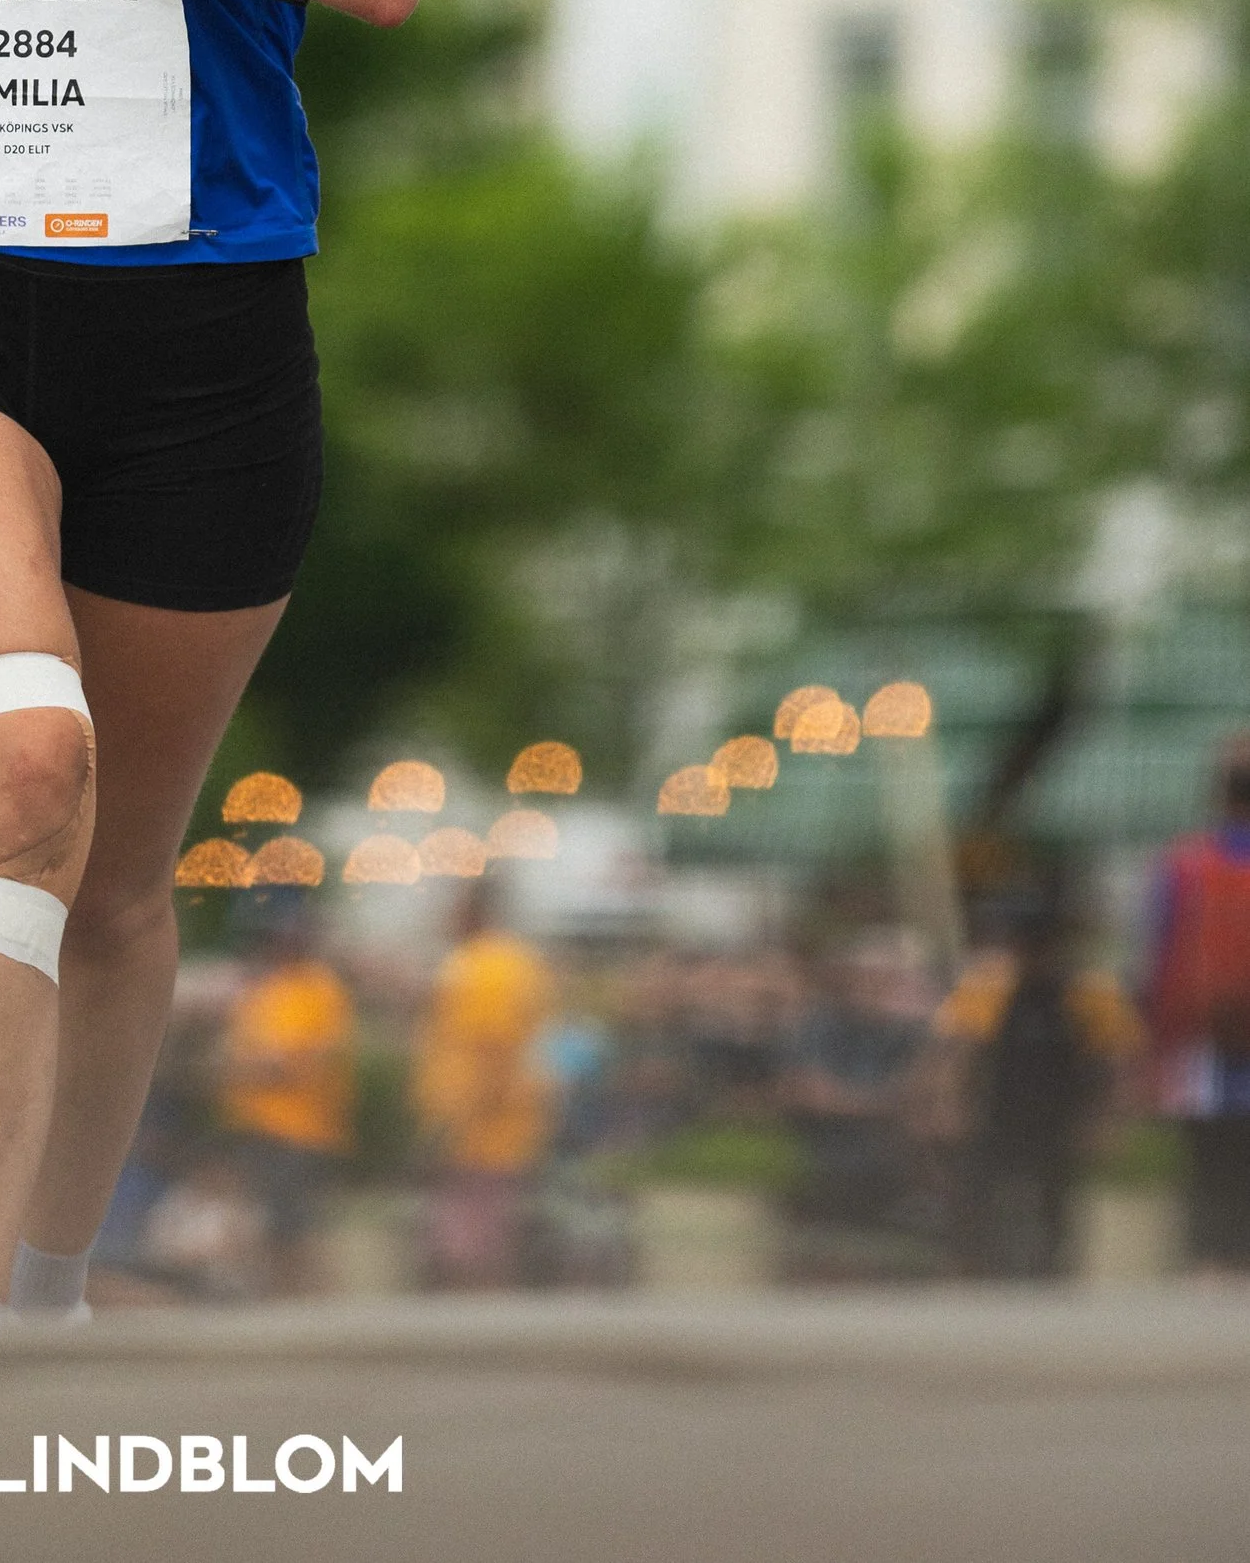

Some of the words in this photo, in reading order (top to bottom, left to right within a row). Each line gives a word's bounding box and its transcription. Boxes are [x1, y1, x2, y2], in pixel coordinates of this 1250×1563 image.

[51, 123, 74, 133] VSK
[4, 144, 26, 155] D20
[28, 144, 51, 155] ELIT
